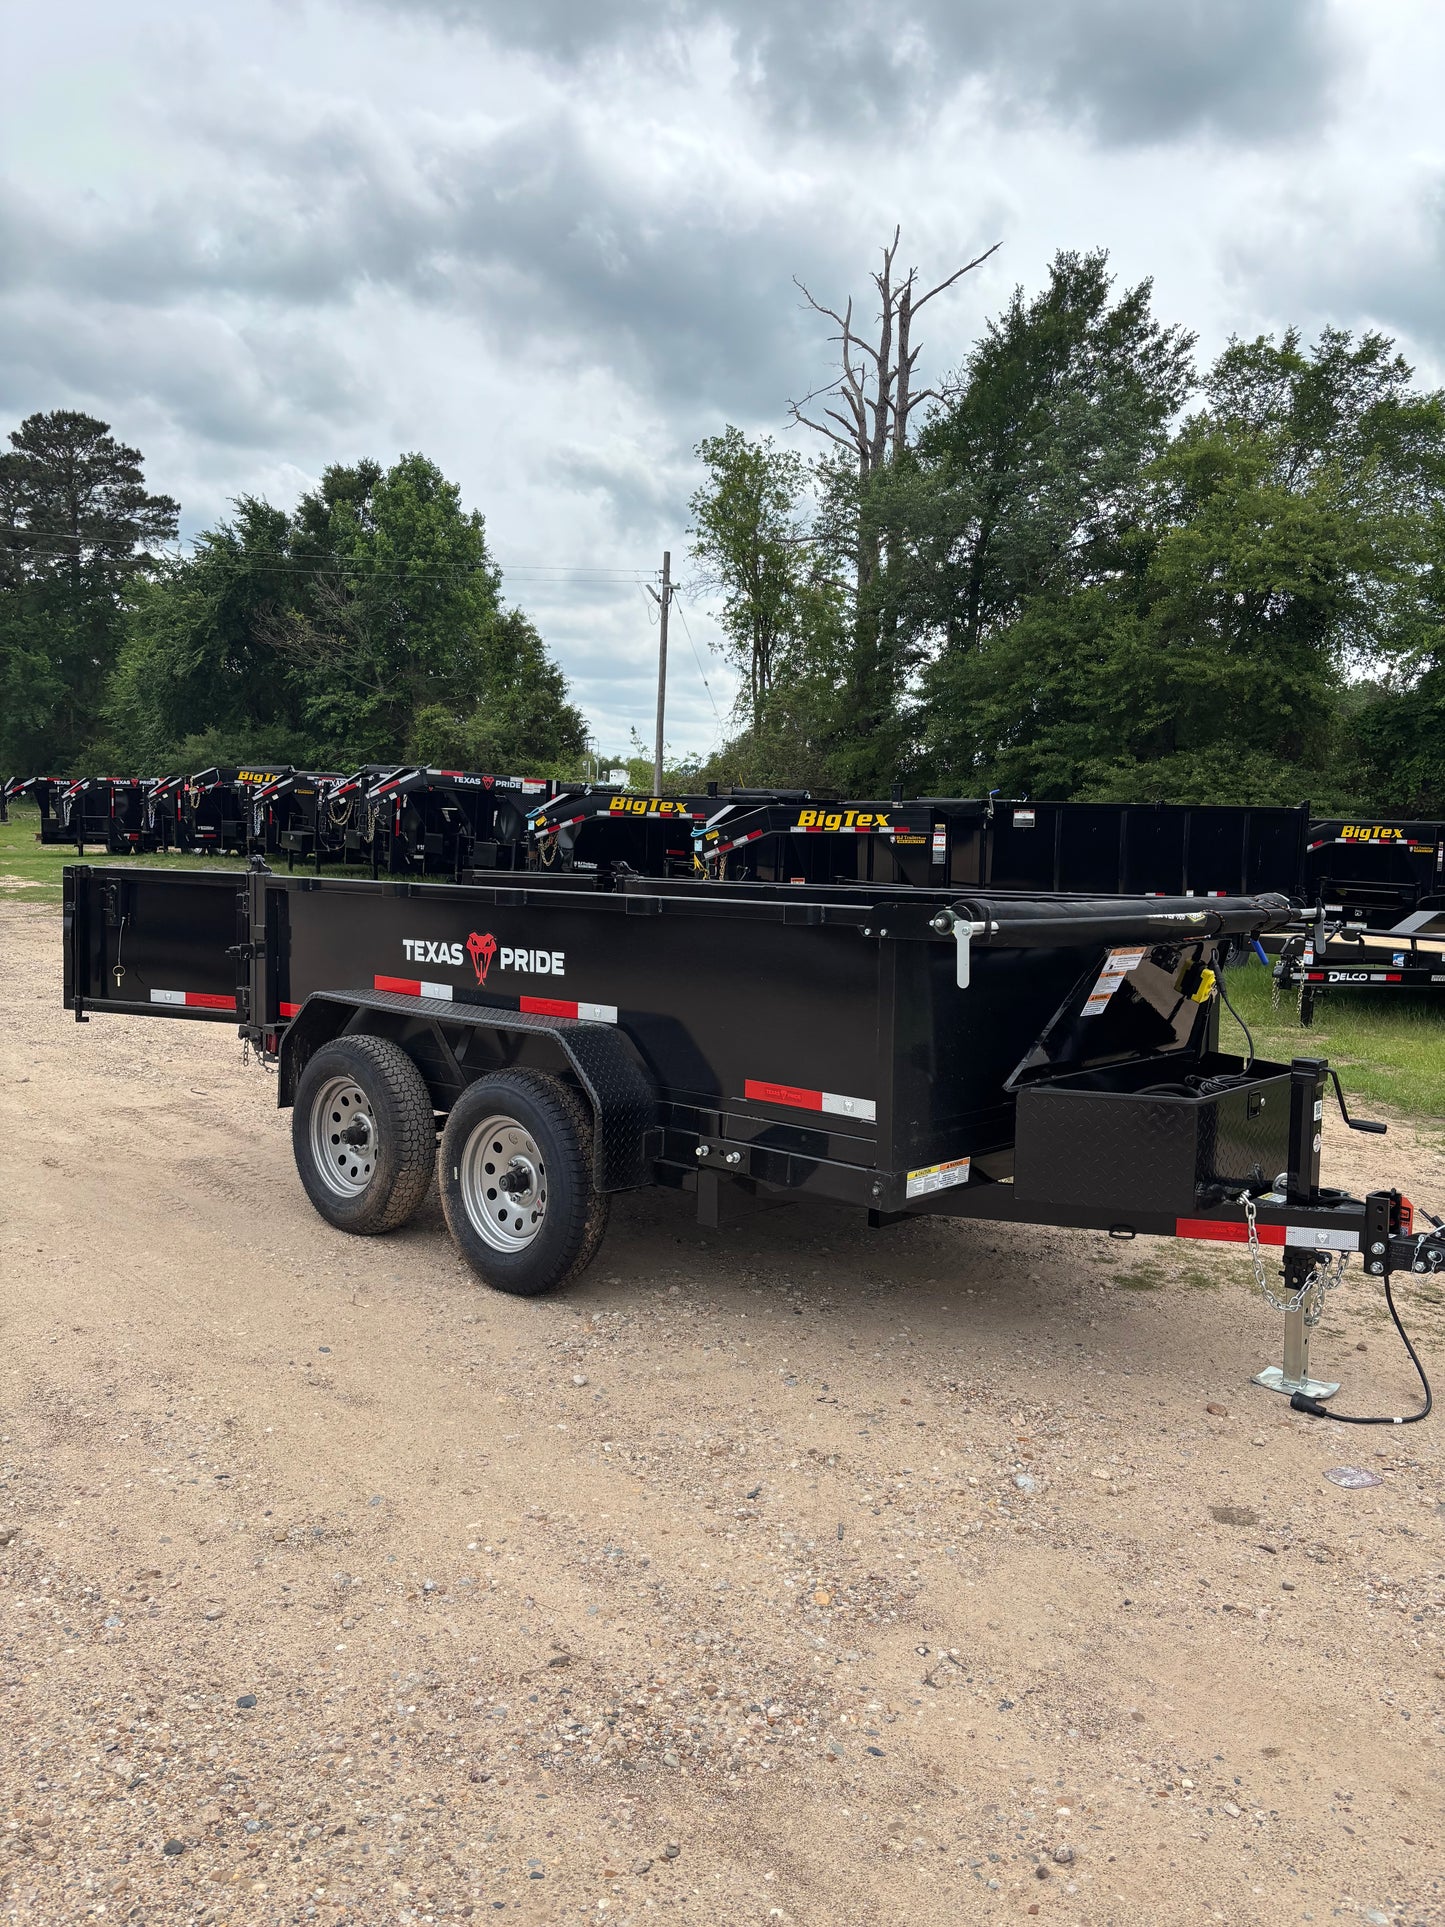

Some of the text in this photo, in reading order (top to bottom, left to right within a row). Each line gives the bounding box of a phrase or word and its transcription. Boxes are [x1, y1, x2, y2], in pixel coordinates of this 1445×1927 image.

[238, 771, 281, 784] BigTe
[453, 775, 481, 785] TEXAS
[495, 780, 521, 789] PRIDE
[609, 796, 688, 815] BigTex
[797, 810, 891, 831] BigTex
[1341, 825, 1404, 841] BigTex
[402, 939, 565, 976] TEXAS PRIDE
[1328, 971, 1368, 982] DELCO
